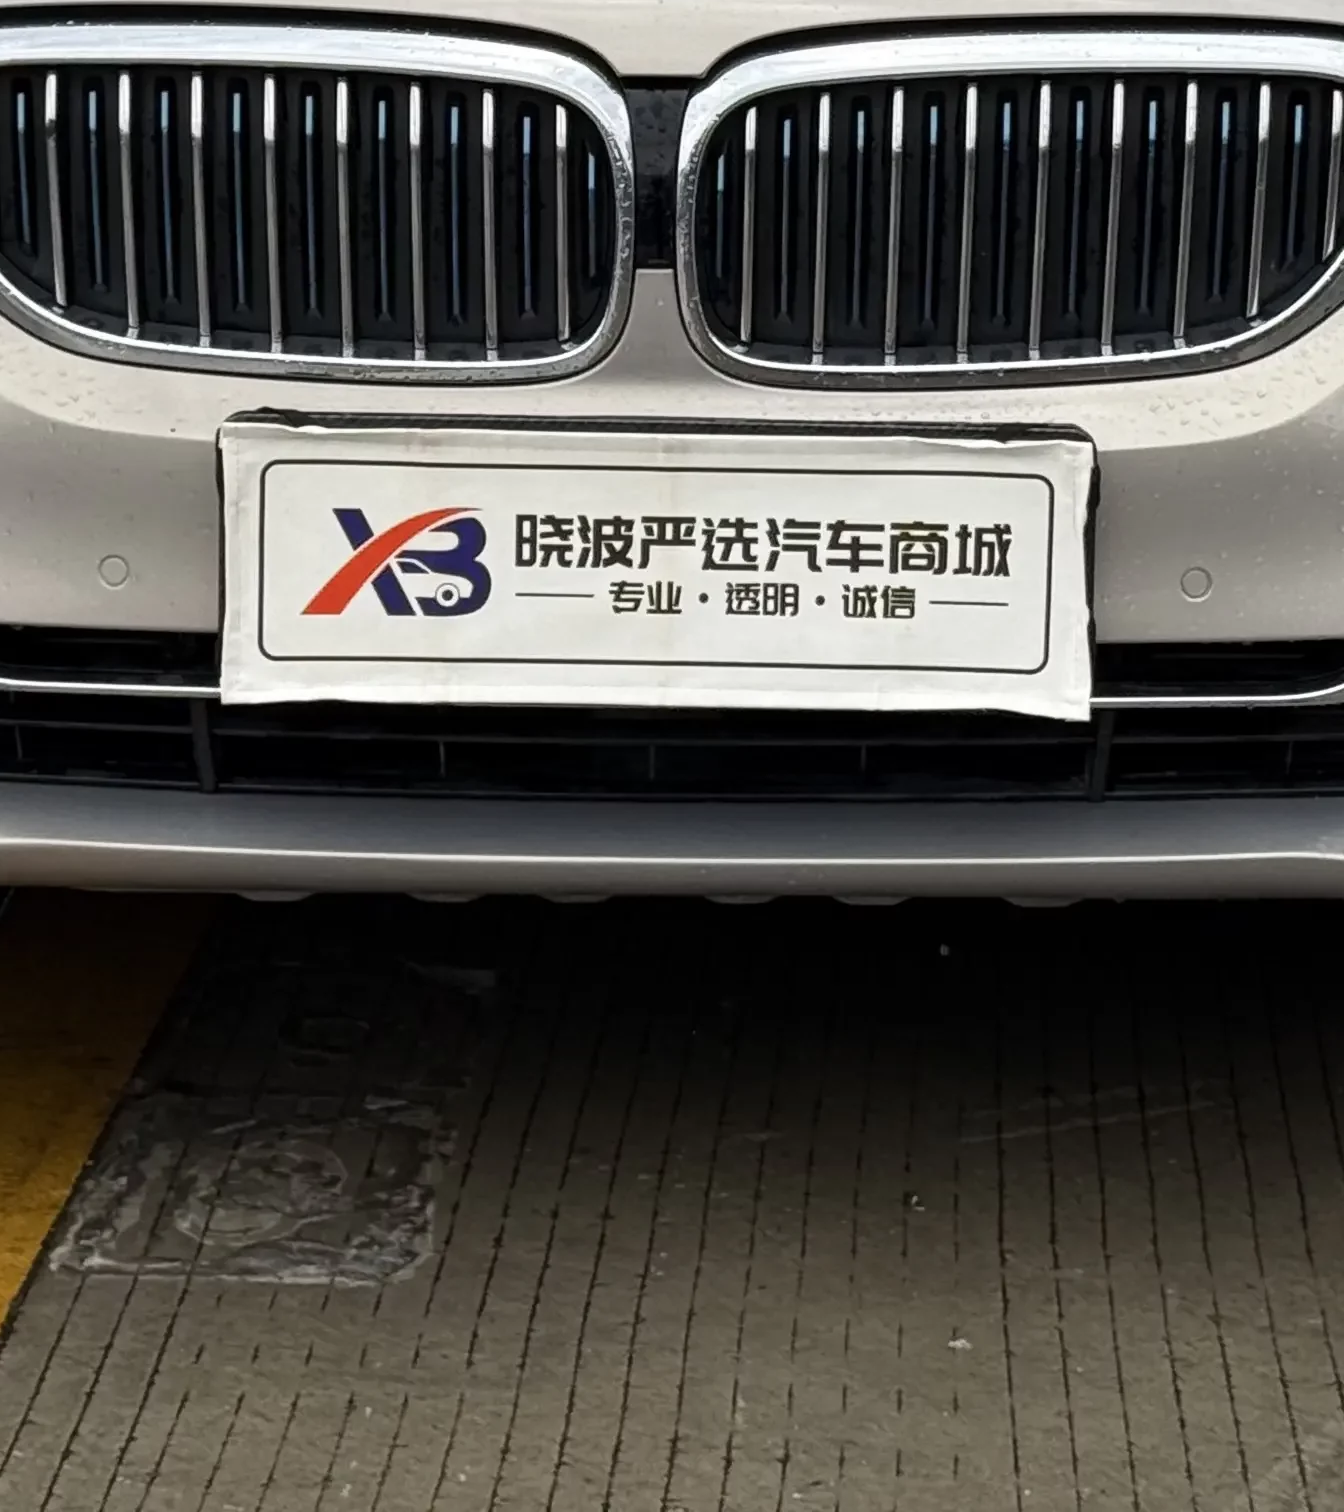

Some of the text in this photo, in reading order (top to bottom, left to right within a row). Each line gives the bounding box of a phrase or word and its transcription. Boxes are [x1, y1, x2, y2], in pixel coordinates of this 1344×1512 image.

[514, 513, 1013, 577] 晓波严选汽车商城
